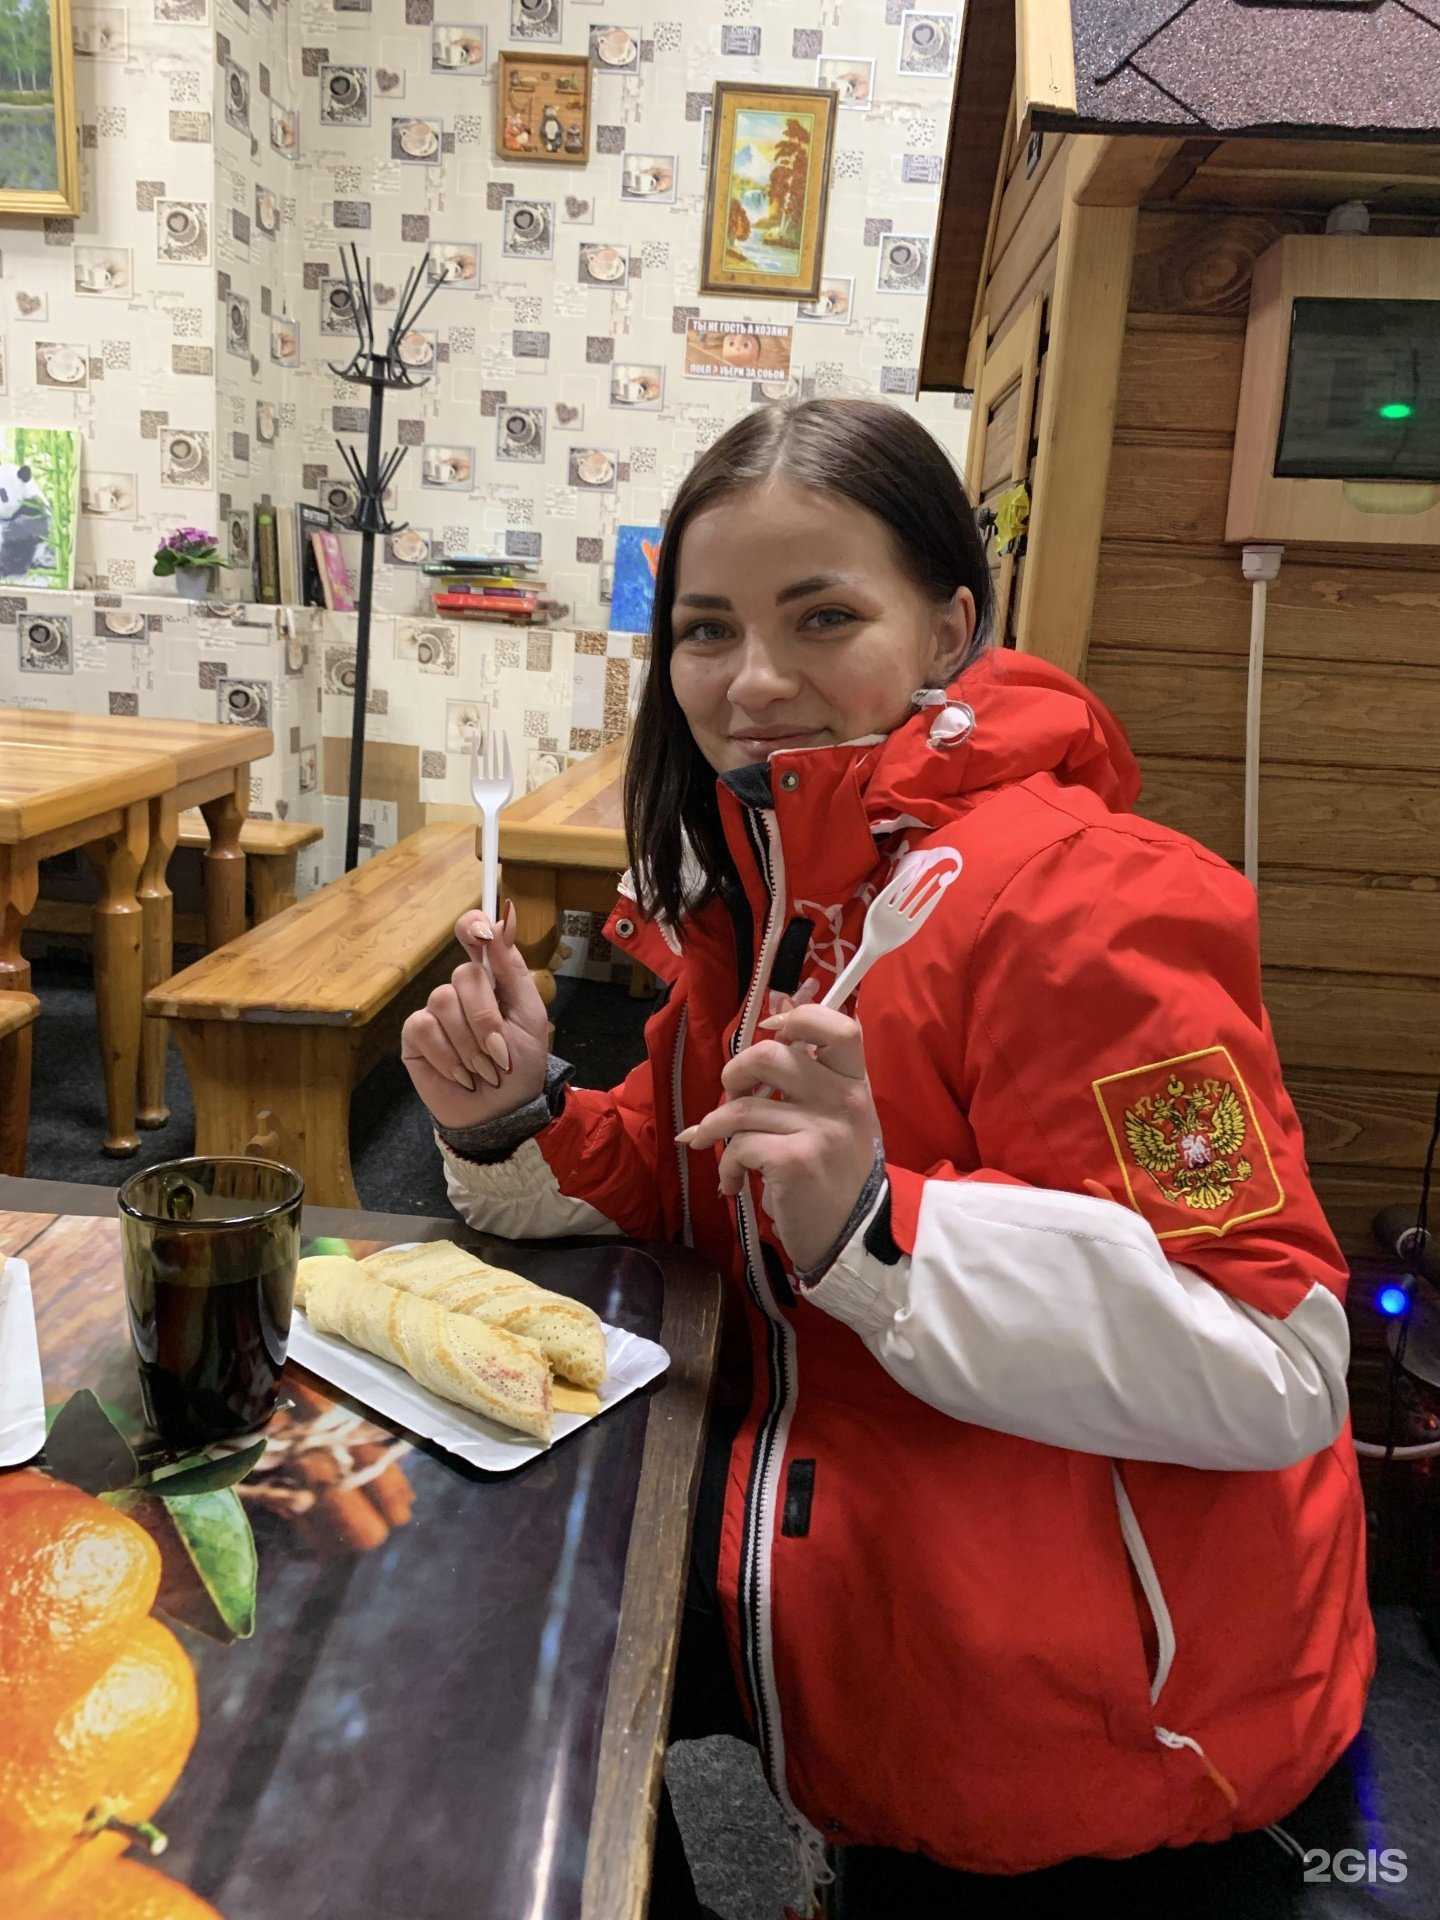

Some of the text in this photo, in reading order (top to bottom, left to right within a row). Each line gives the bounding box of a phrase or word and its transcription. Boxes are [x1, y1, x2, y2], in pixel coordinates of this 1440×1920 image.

[693, 320, 706, 331] ТЫ
[708, 321, 718, 332] НЕ
[720, 322, 746, 334] ГОСТЬ
[755, 324, 789, 337] ХОЗЯИН
